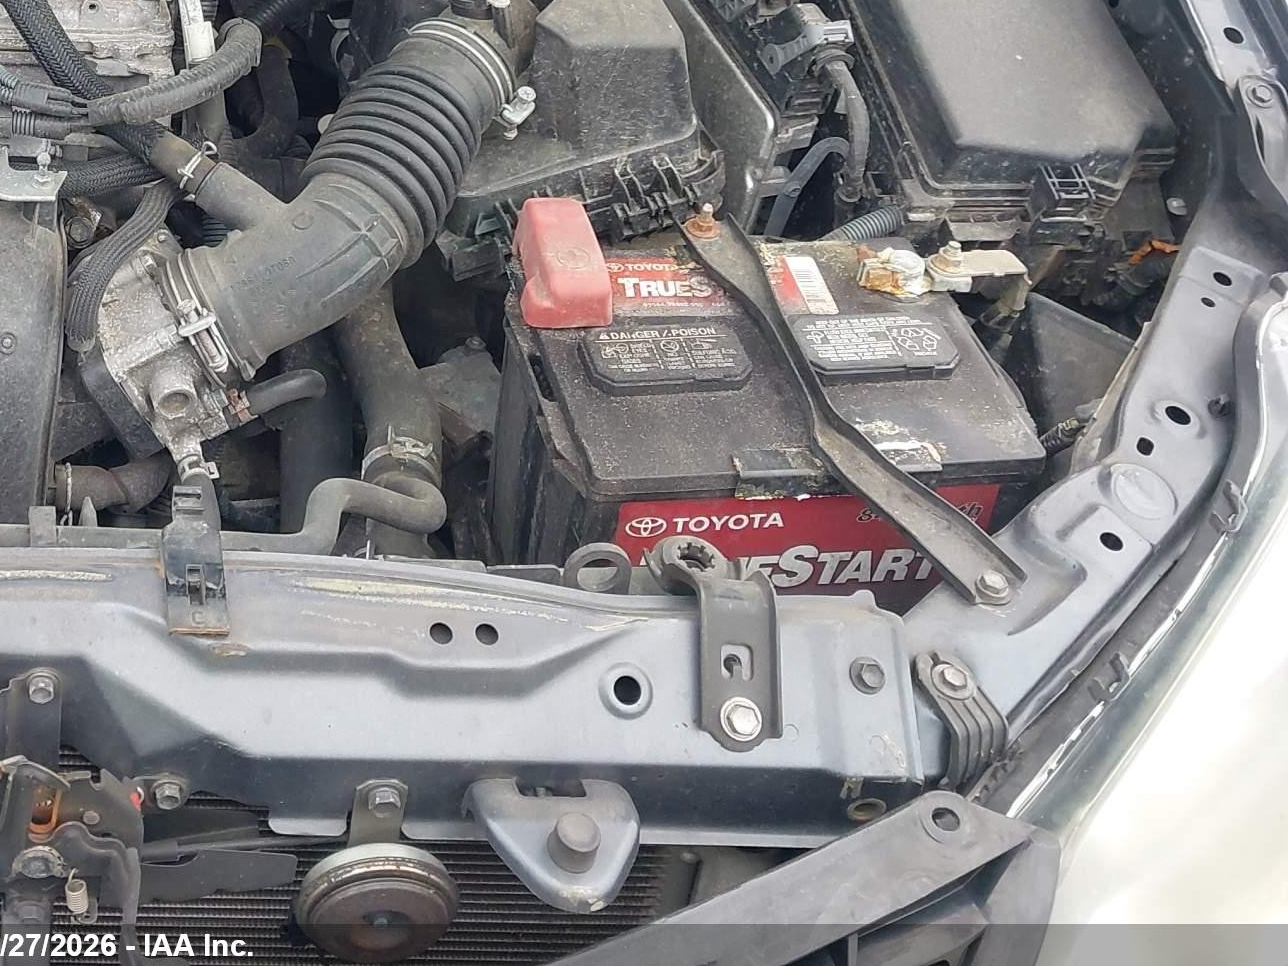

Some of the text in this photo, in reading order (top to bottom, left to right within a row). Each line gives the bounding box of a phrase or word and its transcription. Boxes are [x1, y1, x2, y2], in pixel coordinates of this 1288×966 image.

[617, 276, 713, 298] TRUES
[672, 327, 717, 336] POISON
[672, 512, 784, 533] TOYOTA
[738, 544, 937, 588] ESTART
